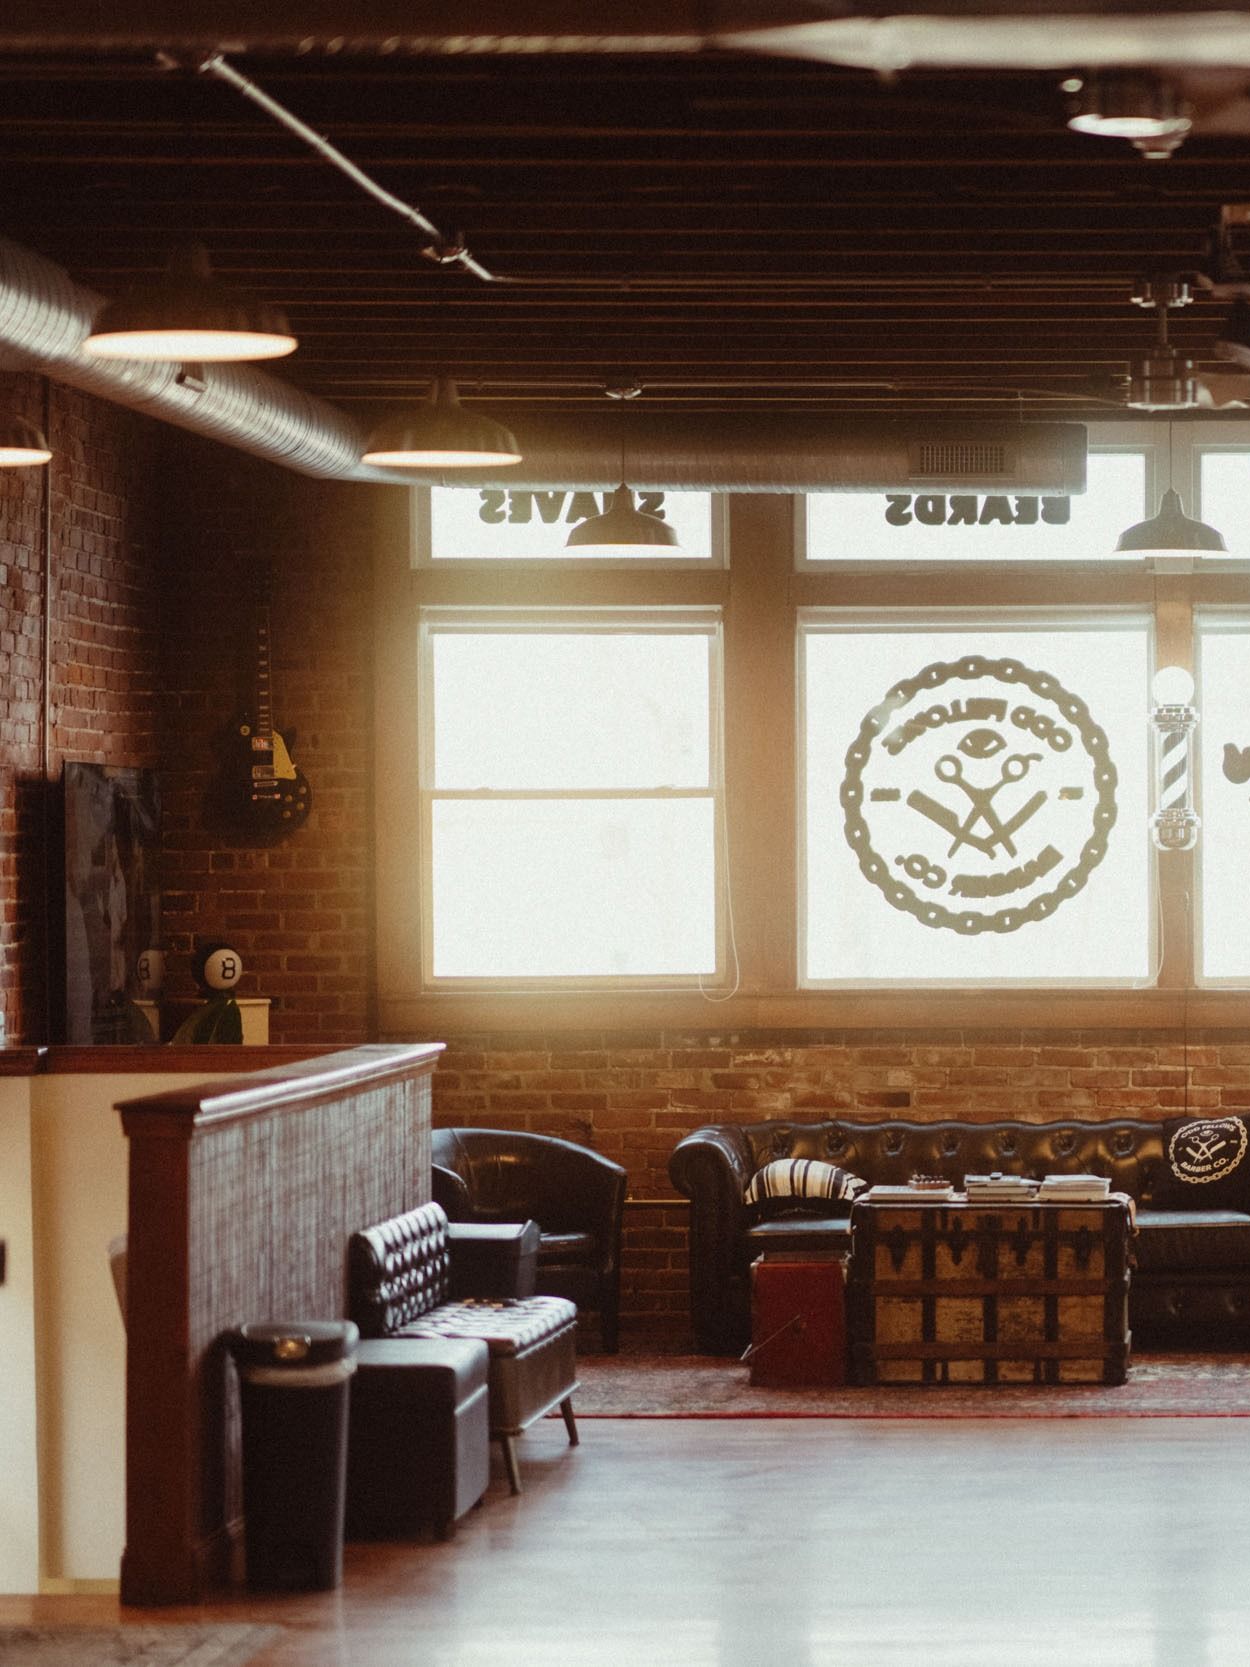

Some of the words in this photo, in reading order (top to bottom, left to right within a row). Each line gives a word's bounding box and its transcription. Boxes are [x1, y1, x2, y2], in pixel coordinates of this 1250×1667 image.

[222, 957, 235, 979] 8
[1180, 1126, 1201, 1139] ODD
[1202, 1123, 1236, 1132] FELLOWS
[1180, 1161, 1212, 1173] BARBER
